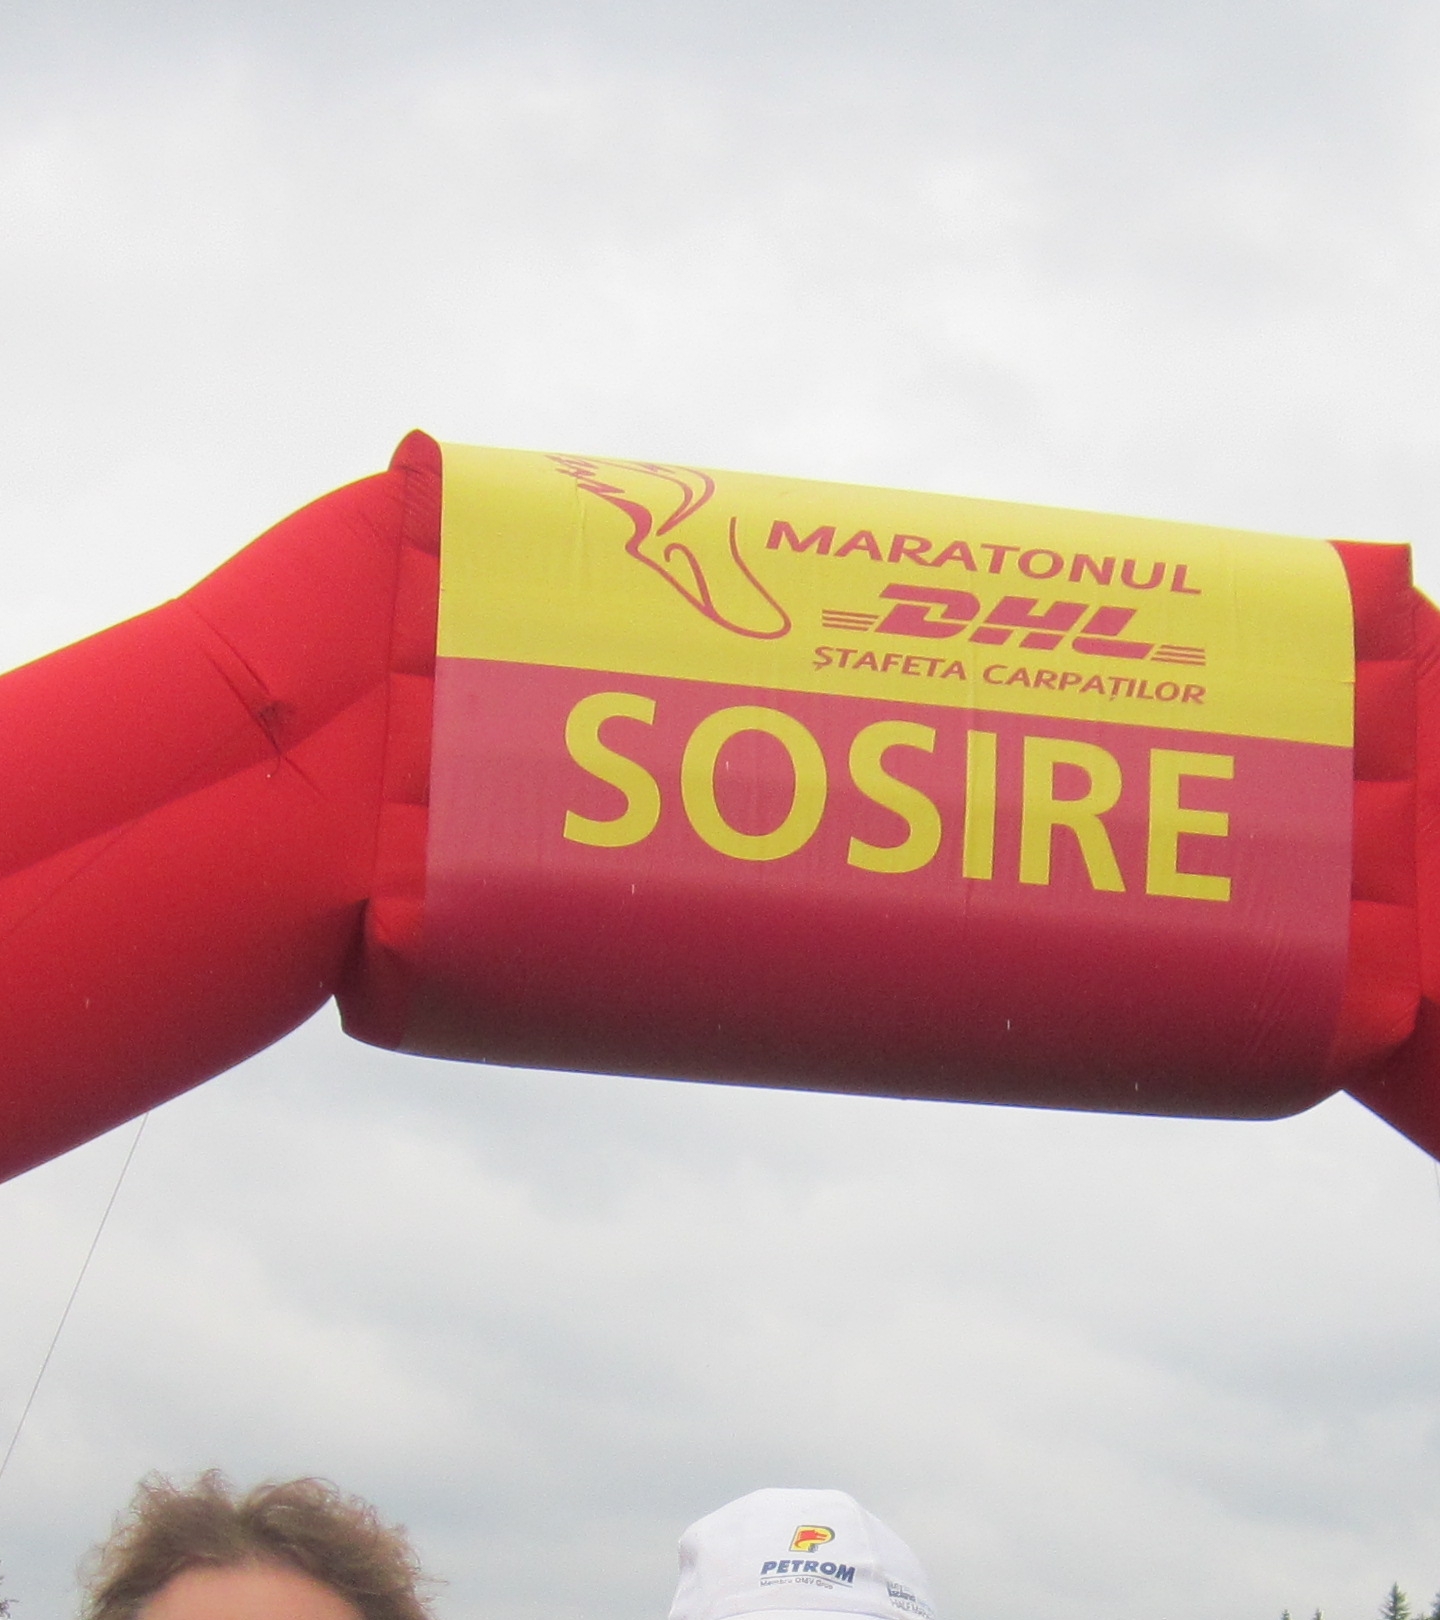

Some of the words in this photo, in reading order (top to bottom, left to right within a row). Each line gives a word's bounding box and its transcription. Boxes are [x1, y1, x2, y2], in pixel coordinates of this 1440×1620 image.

[765, 520, 1202, 595] MARATONUL
[874, 583, 1154, 660] DHL
[563, 691, 1235, 902] SOSIRE
[760, 1560, 856, 1583] PETROM
